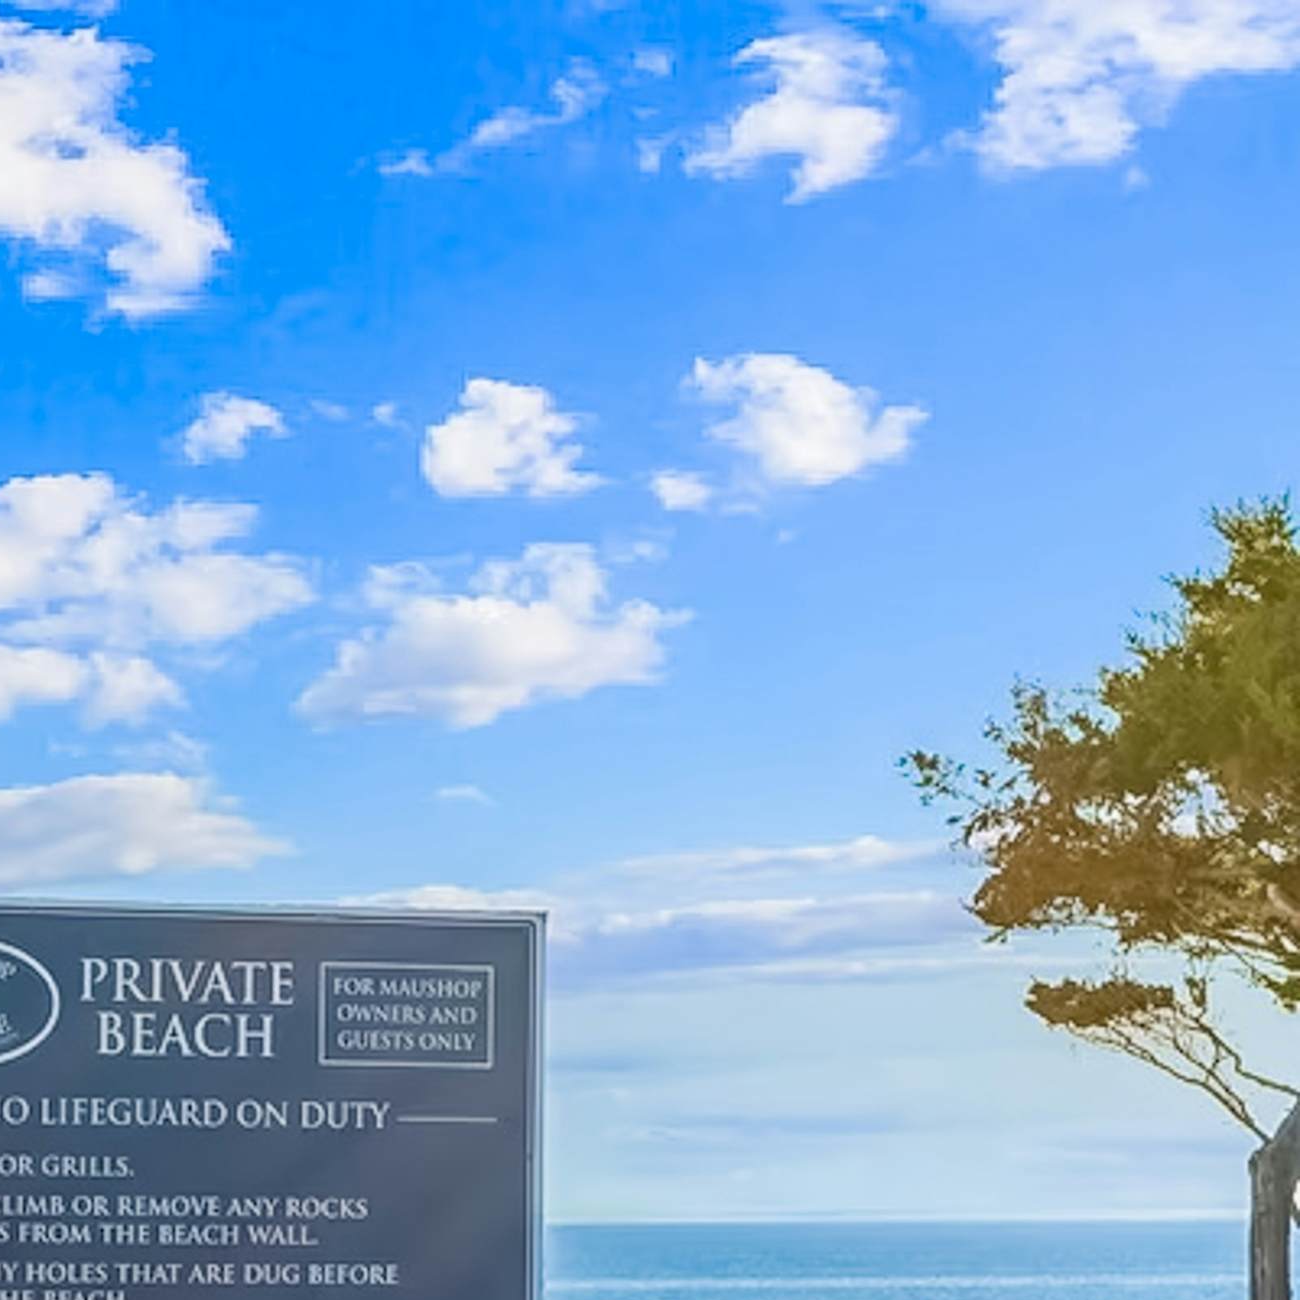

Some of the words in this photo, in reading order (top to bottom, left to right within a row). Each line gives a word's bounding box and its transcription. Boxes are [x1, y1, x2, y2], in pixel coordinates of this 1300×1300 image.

[80, 958, 294, 1005] PRIVATE
[333, 976, 375, 996] FOR
[379, 978, 482, 999] MAUSHOP
[336, 1003, 426, 1025] OWNERS
[428, 1006, 478, 1025] AND
[97, 1010, 274, 1058] BEACH
[337, 1029, 415, 1051] GUESTS
[418, 1032, 476, 1051] ONLY
[41, 1097, 229, 1128] LIFEGUARD
[236, 1099, 289, 1129] ON
[301, 1100, 391, 1129] DUTY
[41, 1154, 134, 1177] GRILLS.
[71, 1195, 111, 1217] OR
[226, 1197, 280, 1218] ANY
[285, 1196, 369, 1220] ROCKS
[18, 1222, 92, 1245] FROM
[98, 1222, 150, 1245] THE
[158, 1223, 240, 1246] BEACH
[247, 1224, 319, 1246] WALL.
[25, 1261, 108, 1285] HOLES
[113, 1263, 183, 1284] THAT
[187, 1263, 235, 1285] ARE
[243, 1263, 300, 1285] DUG
[308, 1263, 399, 1285] BEFORE
